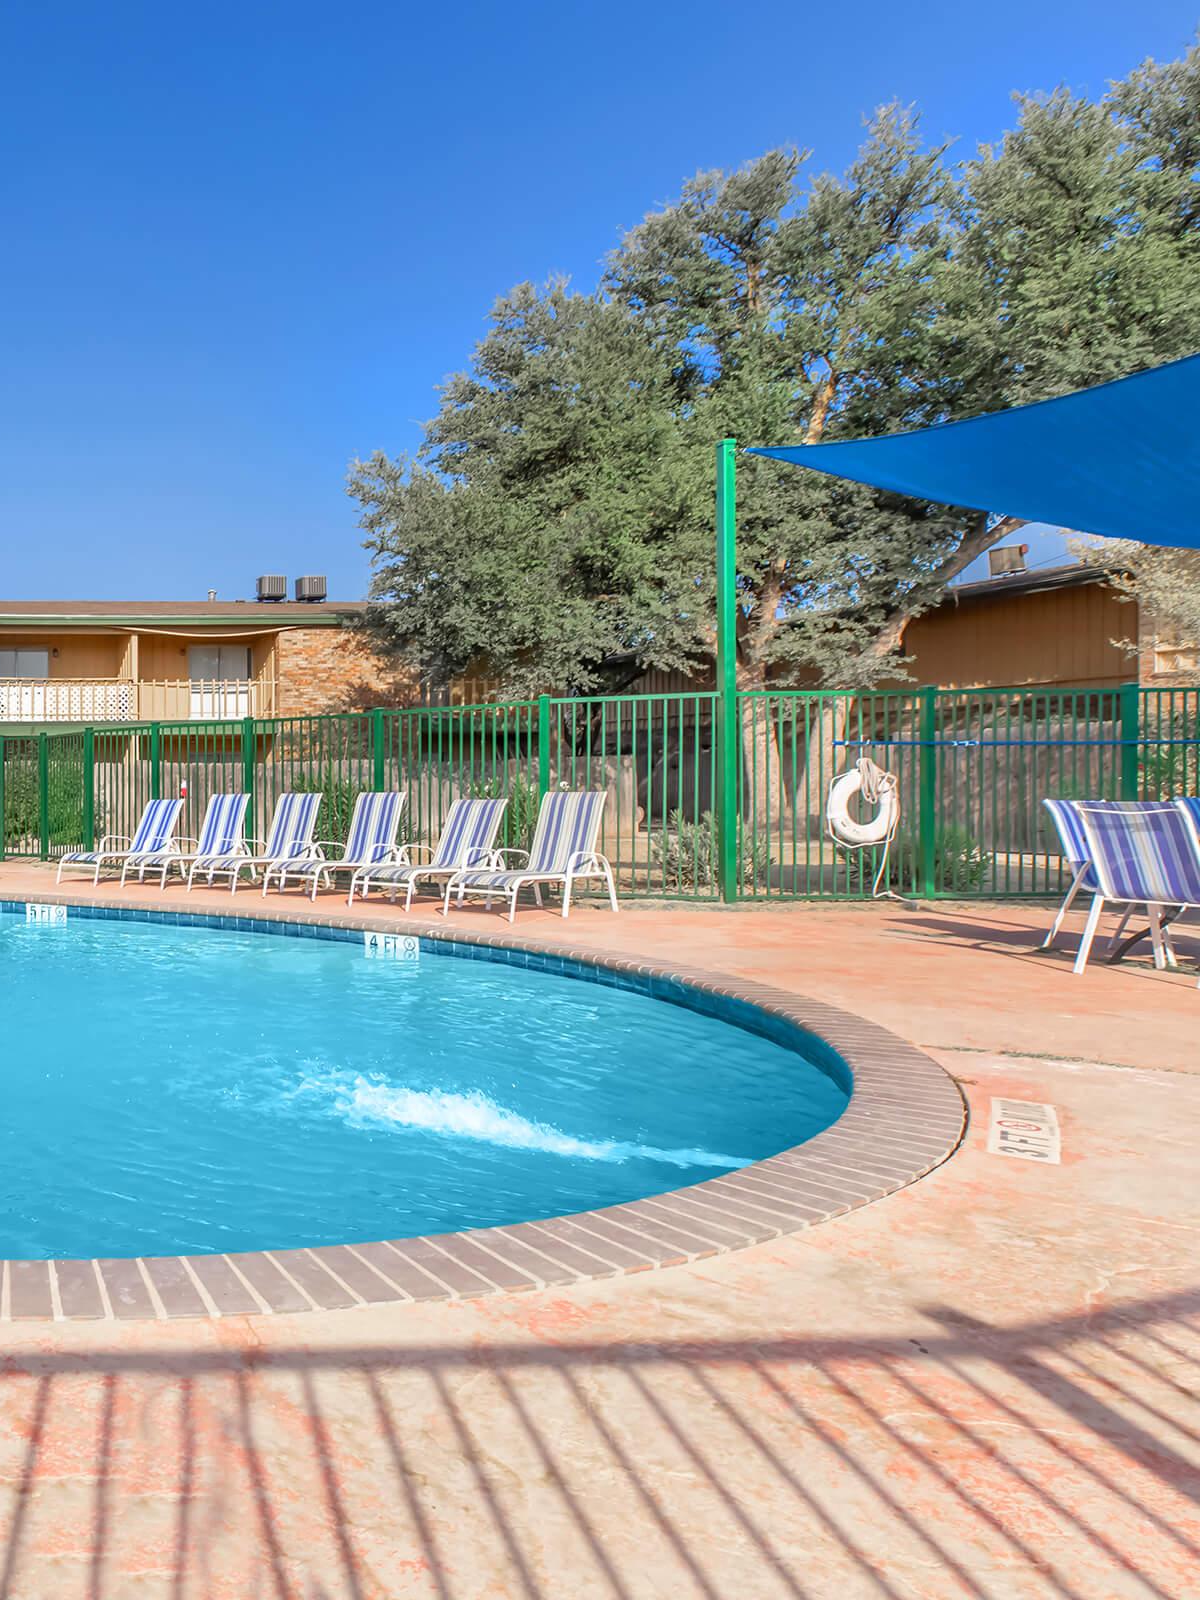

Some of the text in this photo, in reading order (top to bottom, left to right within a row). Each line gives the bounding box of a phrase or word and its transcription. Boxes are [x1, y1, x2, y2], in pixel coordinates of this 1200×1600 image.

[41, 905, 52, 918] FT
[369, 935, 399, 949] 4 FT
[1000, 1130, 1051, 1148] FT
[998, 1146, 1048, 1158] 3
